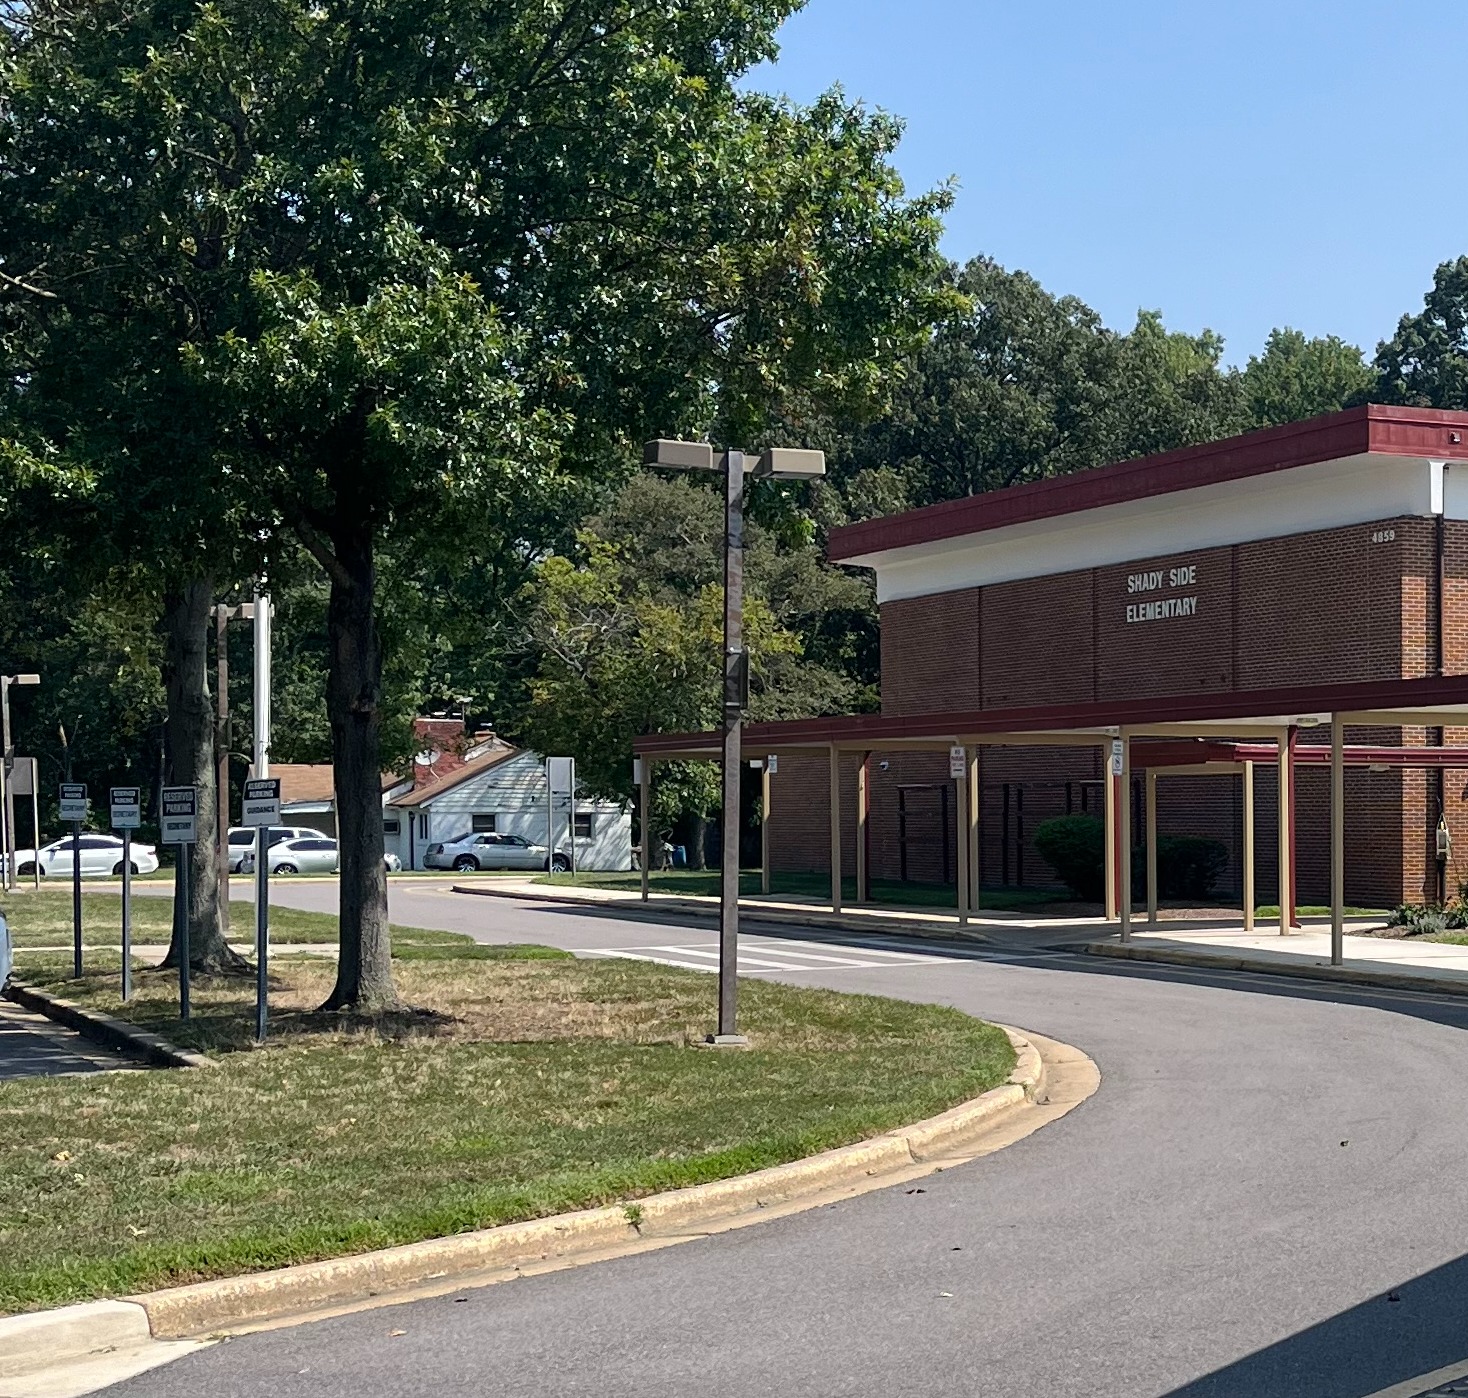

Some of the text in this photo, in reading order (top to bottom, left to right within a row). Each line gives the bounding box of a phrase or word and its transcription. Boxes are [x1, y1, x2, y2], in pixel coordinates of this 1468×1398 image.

[1372, 530, 1395, 543] 4859
[1127, 565, 1197, 594] SHADY SIDE
[1126, 596, 1198, 623] ELEMENTARY
